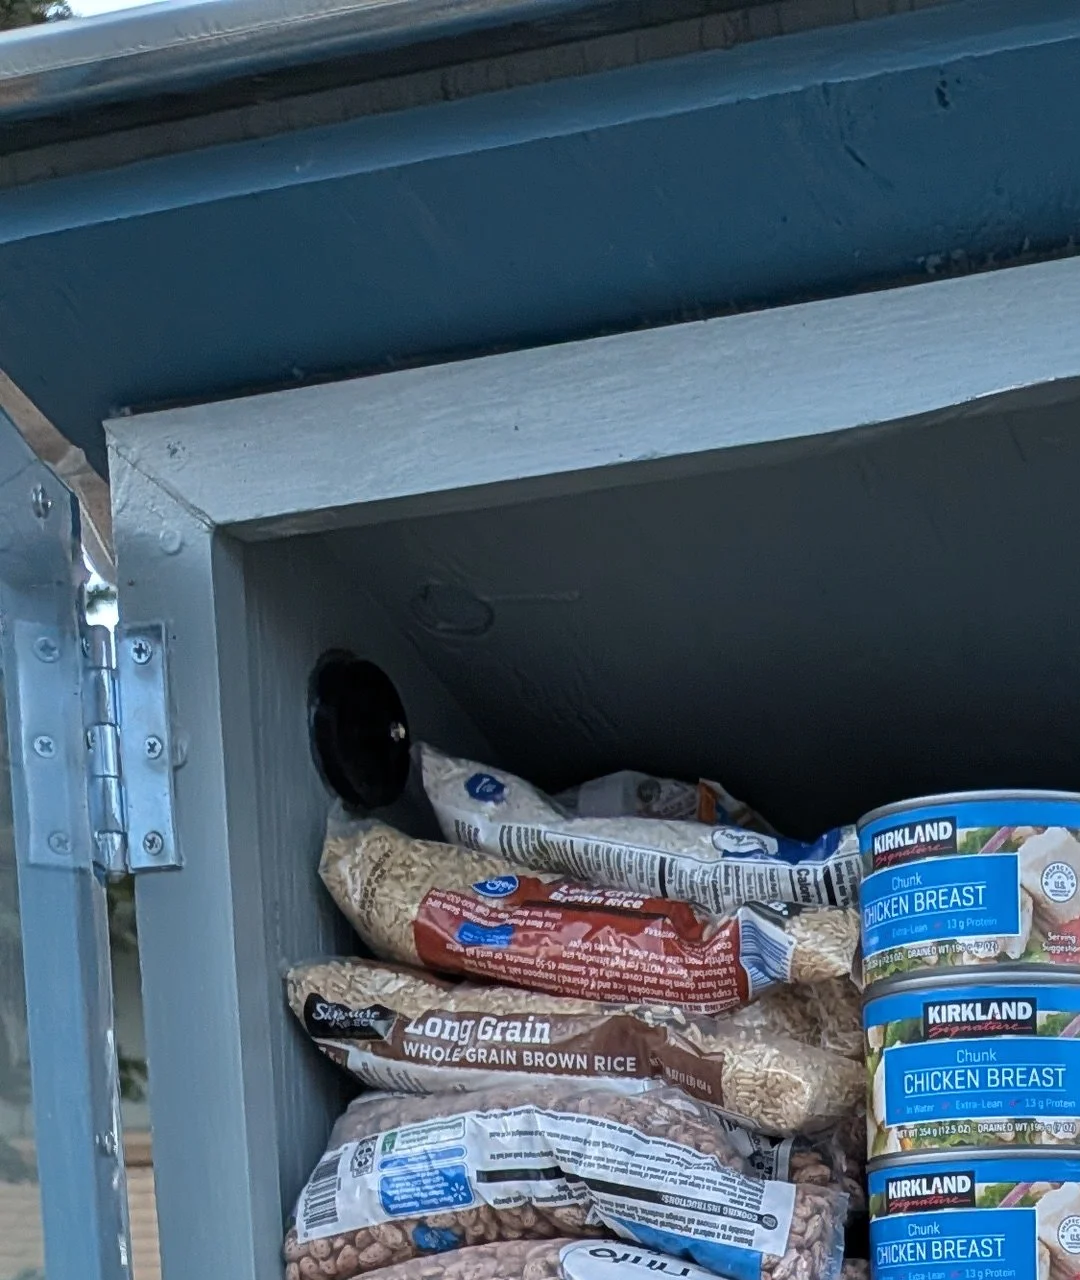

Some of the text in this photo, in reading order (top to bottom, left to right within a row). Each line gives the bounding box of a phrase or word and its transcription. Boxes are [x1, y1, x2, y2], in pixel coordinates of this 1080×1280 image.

[873, 820, 954, 856] KIRKLAND
[892, 873, 922, 890] Chunk
[864, 885, 987, 928] CHICKEN BREAST
[928, 1001, 1034, 1025] KIRKLAND
[405, 1015, 476, 1044] Long
[477, 1015, 551, 1045] Grain
[402, 1042, 637, 1072] WHOLE GRAIN BROWN RICE
[956, 1048, 998, 1063] Chunk
[904, 1066, 1067, 1094] CHICKEN BREAST
[913, 1103, 936, 1115] Water
[955, 1097, 1004, 1110] Extra-Lean
[1025, 1099, 1034, 1110] 13
[1046, 1098, 1076, 1109] Protein
[888, 1174, 972, 1200] KIRKLAND
[660, 1193, 758, 1222] COOKING INSTRUCTIONS:
[908, 1221, 940, 1236] Chunk
[876, 1237, 1006, 1265] CHICKEN BREAST
